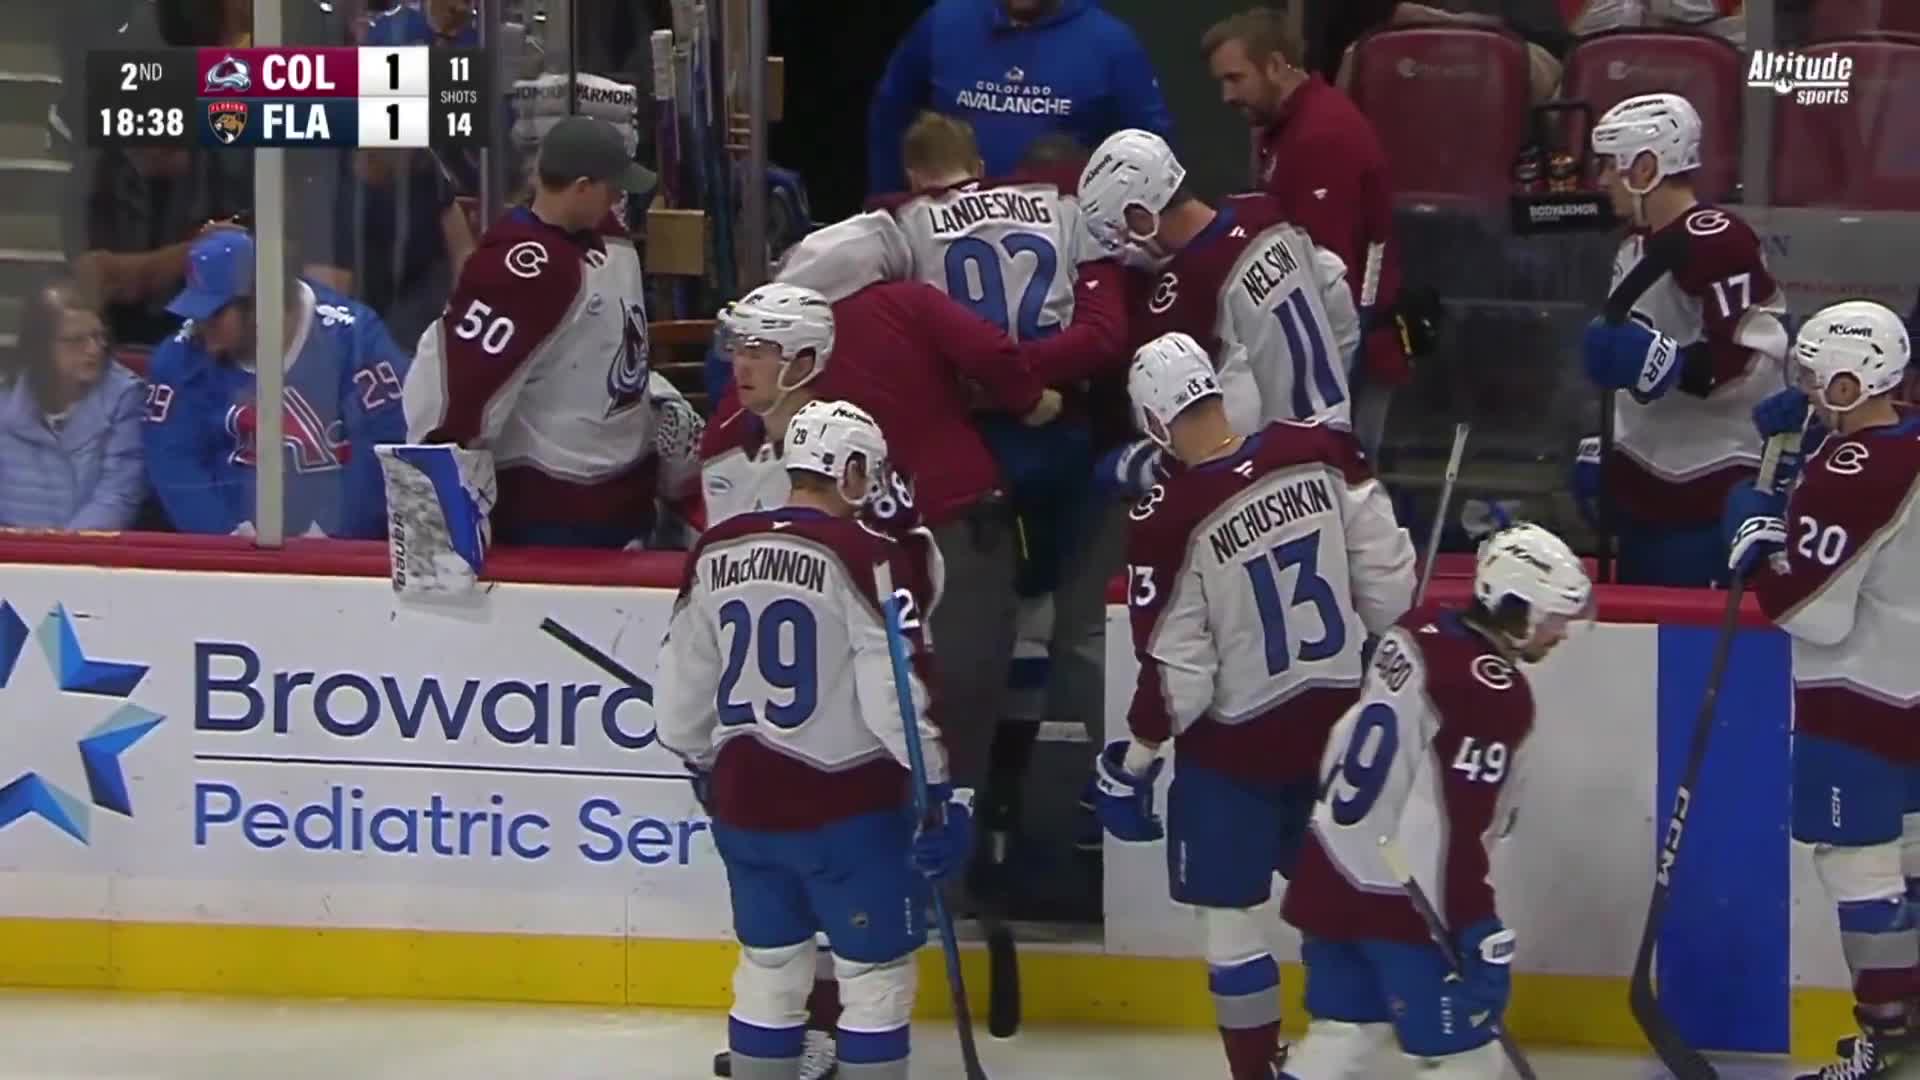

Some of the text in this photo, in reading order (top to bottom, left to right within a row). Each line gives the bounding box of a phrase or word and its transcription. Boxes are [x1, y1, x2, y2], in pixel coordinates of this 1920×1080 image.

[956, 90, 1073, 116] AVALANCHE
[929, 188, 1052, 235] LANDESKOG
[1241, 241, 1297, 305] NELSON
[1711, 273, 1752, 318] 17
[455, 301, 514, 355] 50
[1273, 291, 1345, 419] 11
[352, 360, 402, 411] 29
[793, 427, 808, 446] 29
[1210, 478, 1333, 566] NICHUSHKIN
[1798, 515, 1848, 566] 20
[1242, 528, 1346, 678] 13
[716, 598, 819, 730] 29
[1452, 735, 1508, 784] 49
[194, 782, 550, 860] Pediatric
[1656, 784, 1691, 887] CCM
